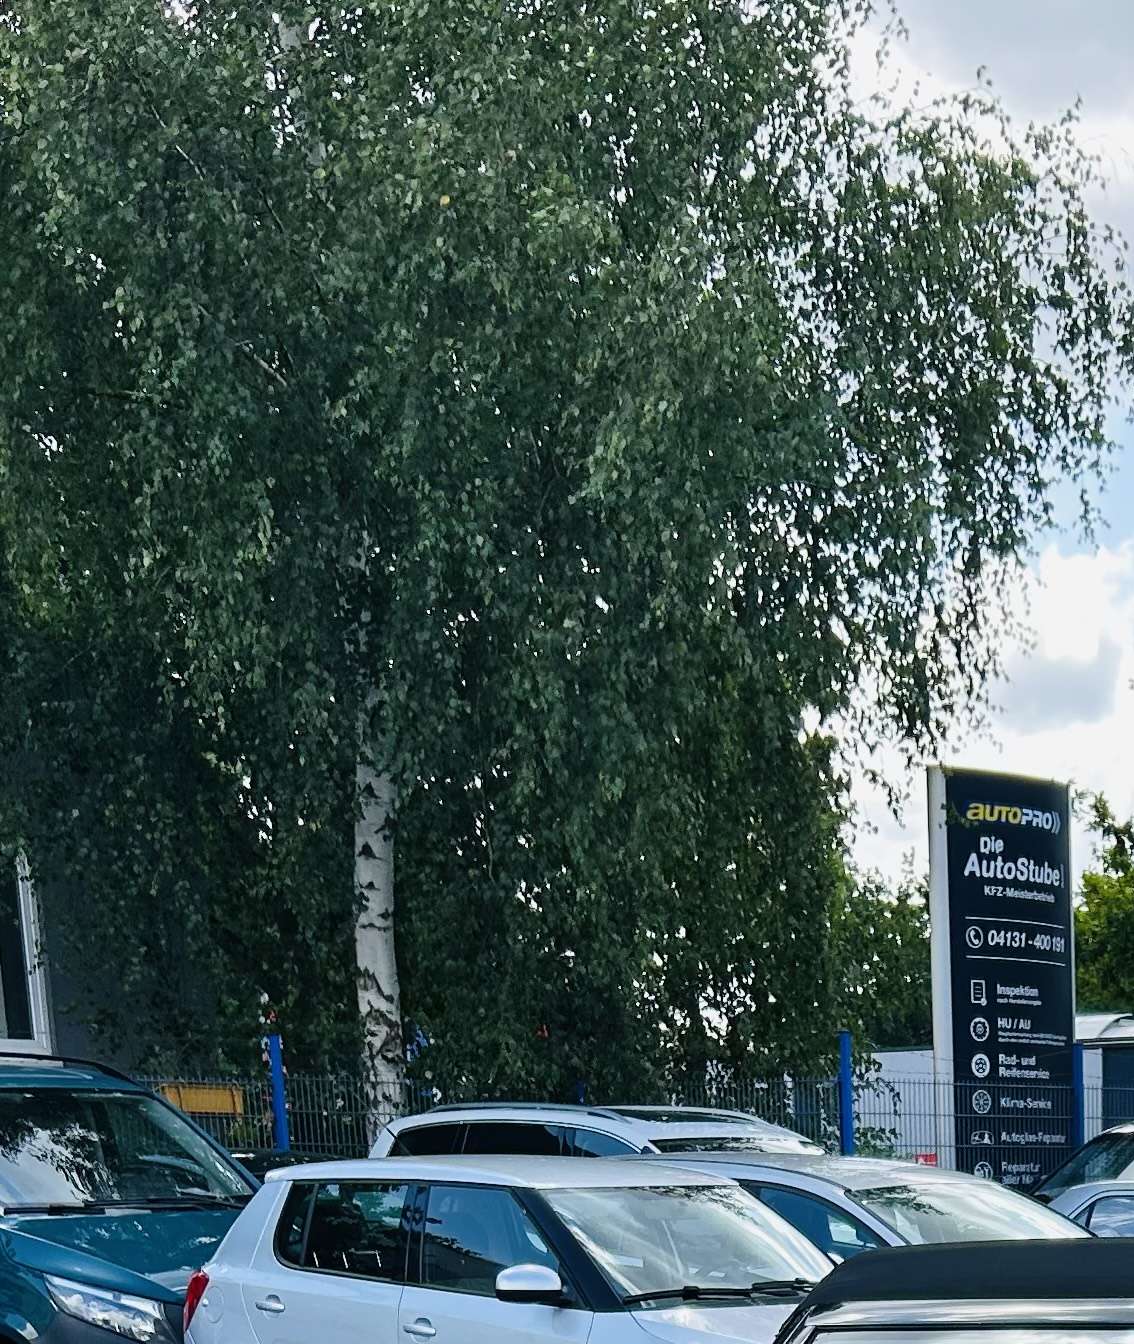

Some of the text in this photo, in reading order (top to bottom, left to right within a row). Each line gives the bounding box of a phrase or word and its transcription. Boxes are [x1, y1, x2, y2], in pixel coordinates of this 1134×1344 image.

[979, 835, 1005, 855] Die
[963, 853, 1060, 887] AutoStube
[987, 929, 1026, 948] 04131
[996, 984, 1039, 998] Inspektion
[998, 1053, 1020, 1065] Rad-
[998, 1066, 1050, 1080] Reifenservice
